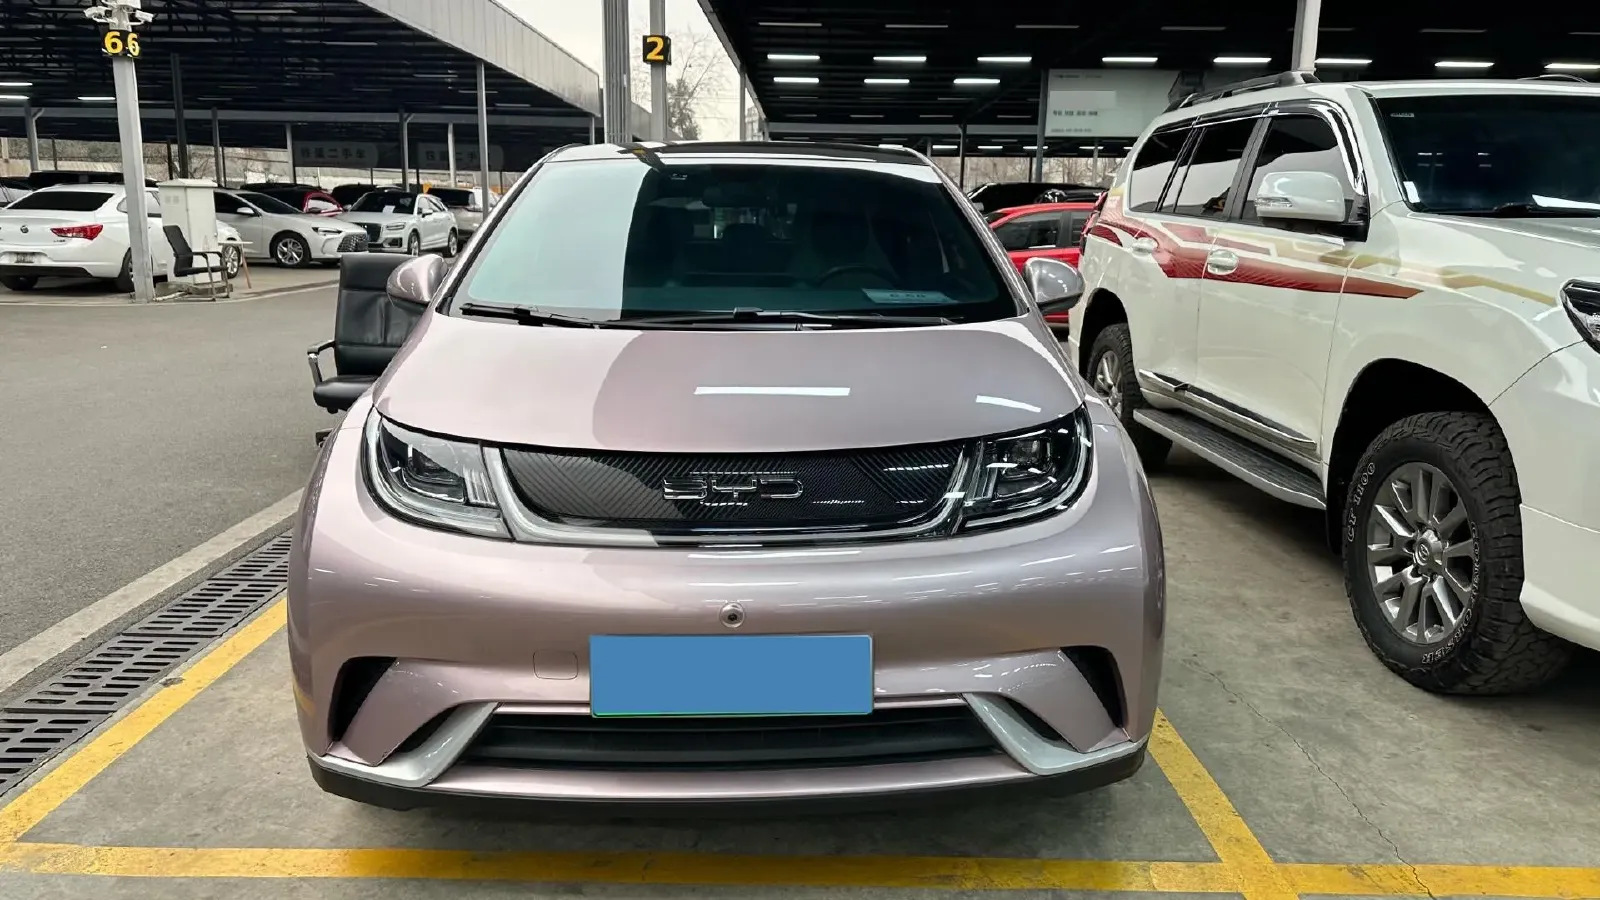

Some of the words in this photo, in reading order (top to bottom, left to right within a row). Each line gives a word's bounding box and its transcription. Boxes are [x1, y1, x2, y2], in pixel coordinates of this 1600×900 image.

[104, 30, 123, 54] 6
[646, 36, 664, 60] 2
[661, 475, 805, 501] BYD
